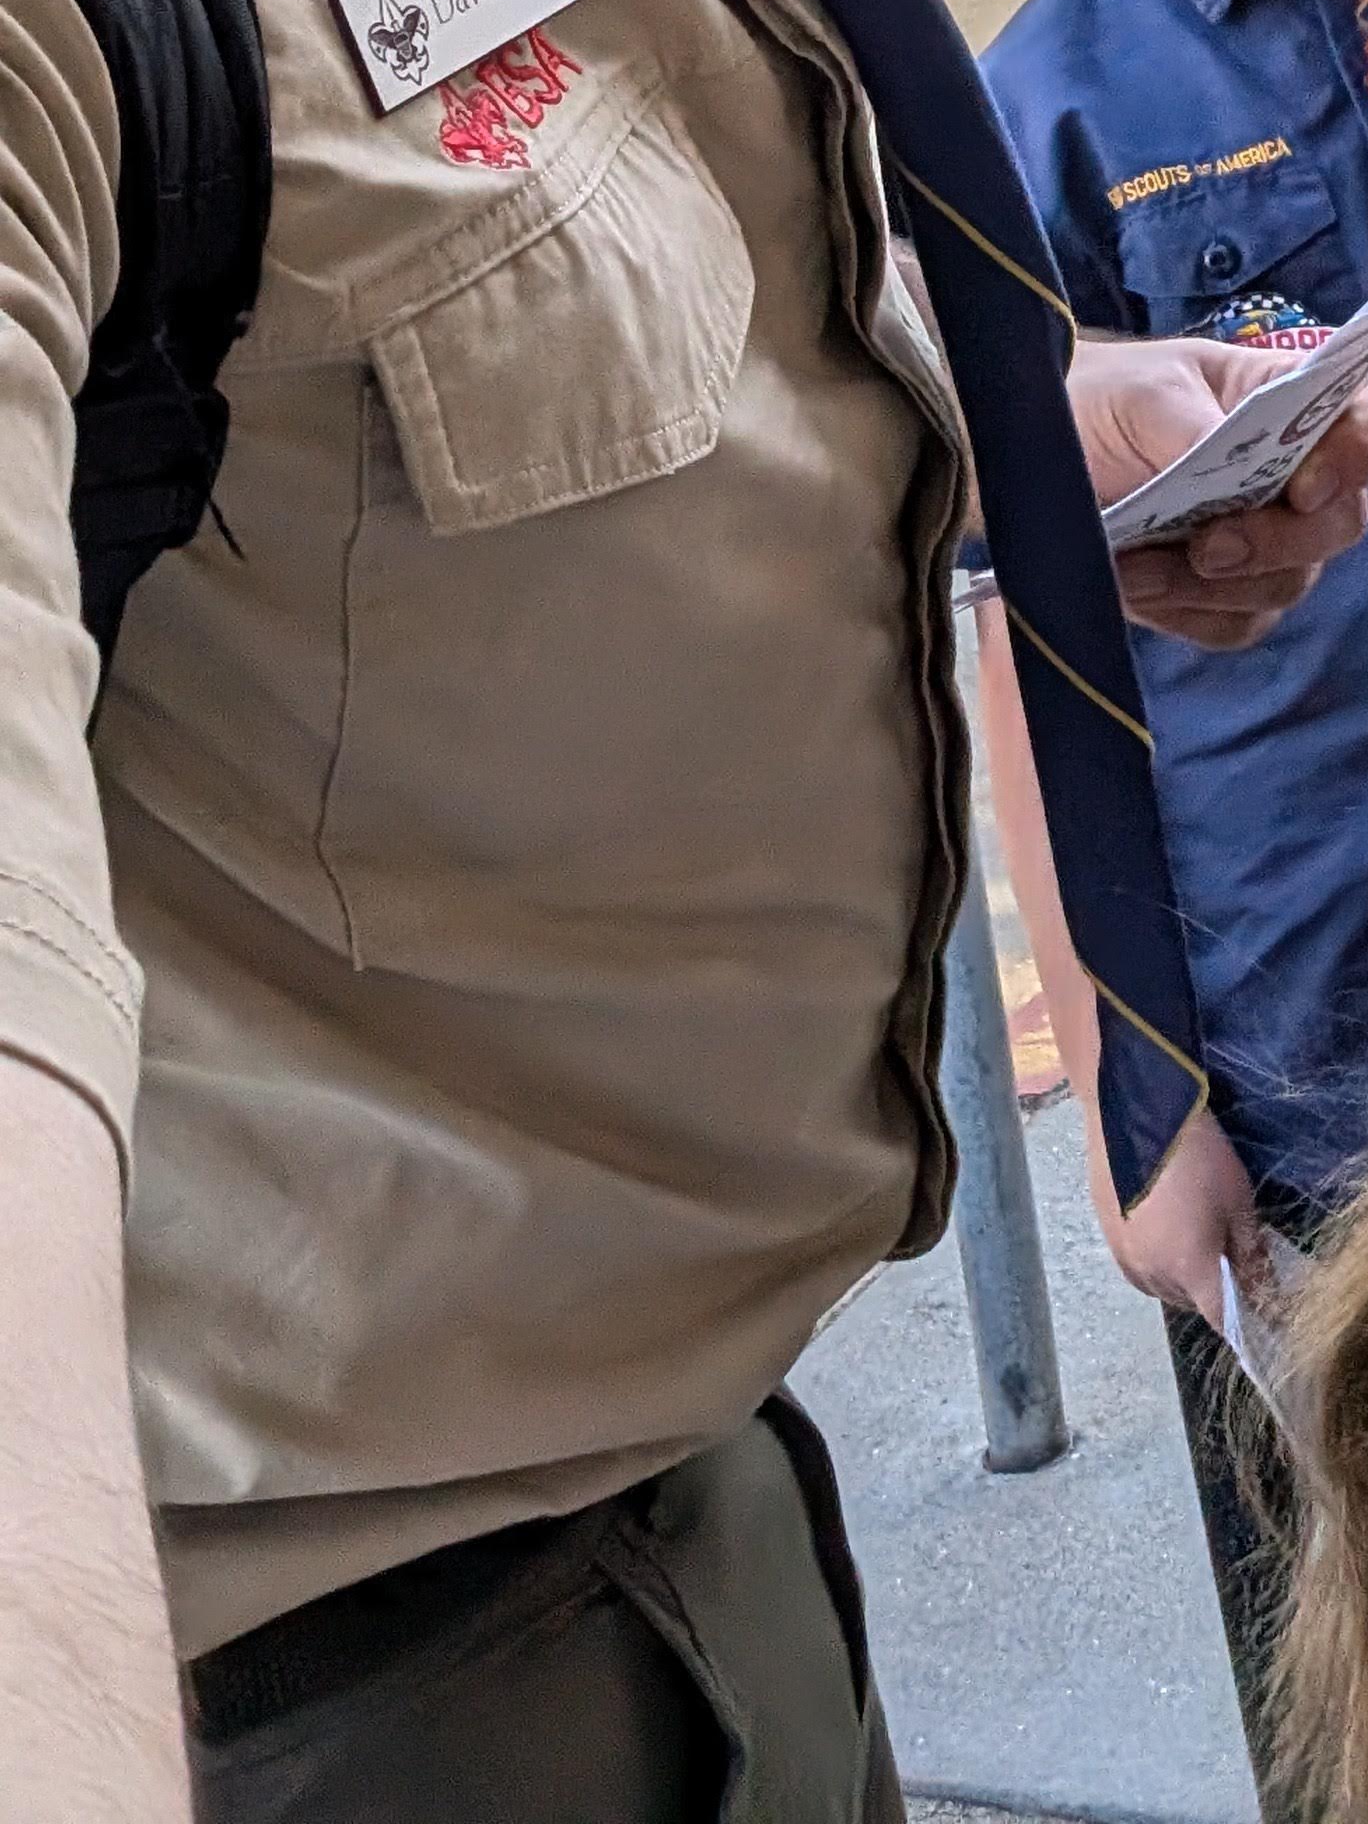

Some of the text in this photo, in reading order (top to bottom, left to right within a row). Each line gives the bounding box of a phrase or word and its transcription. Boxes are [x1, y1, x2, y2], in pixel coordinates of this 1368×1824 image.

[476, 27, 583, 129] BSA
[1122, 164, 1192, 202] SCOUTS
[1216, 136, 1293, 175] AMERICA
